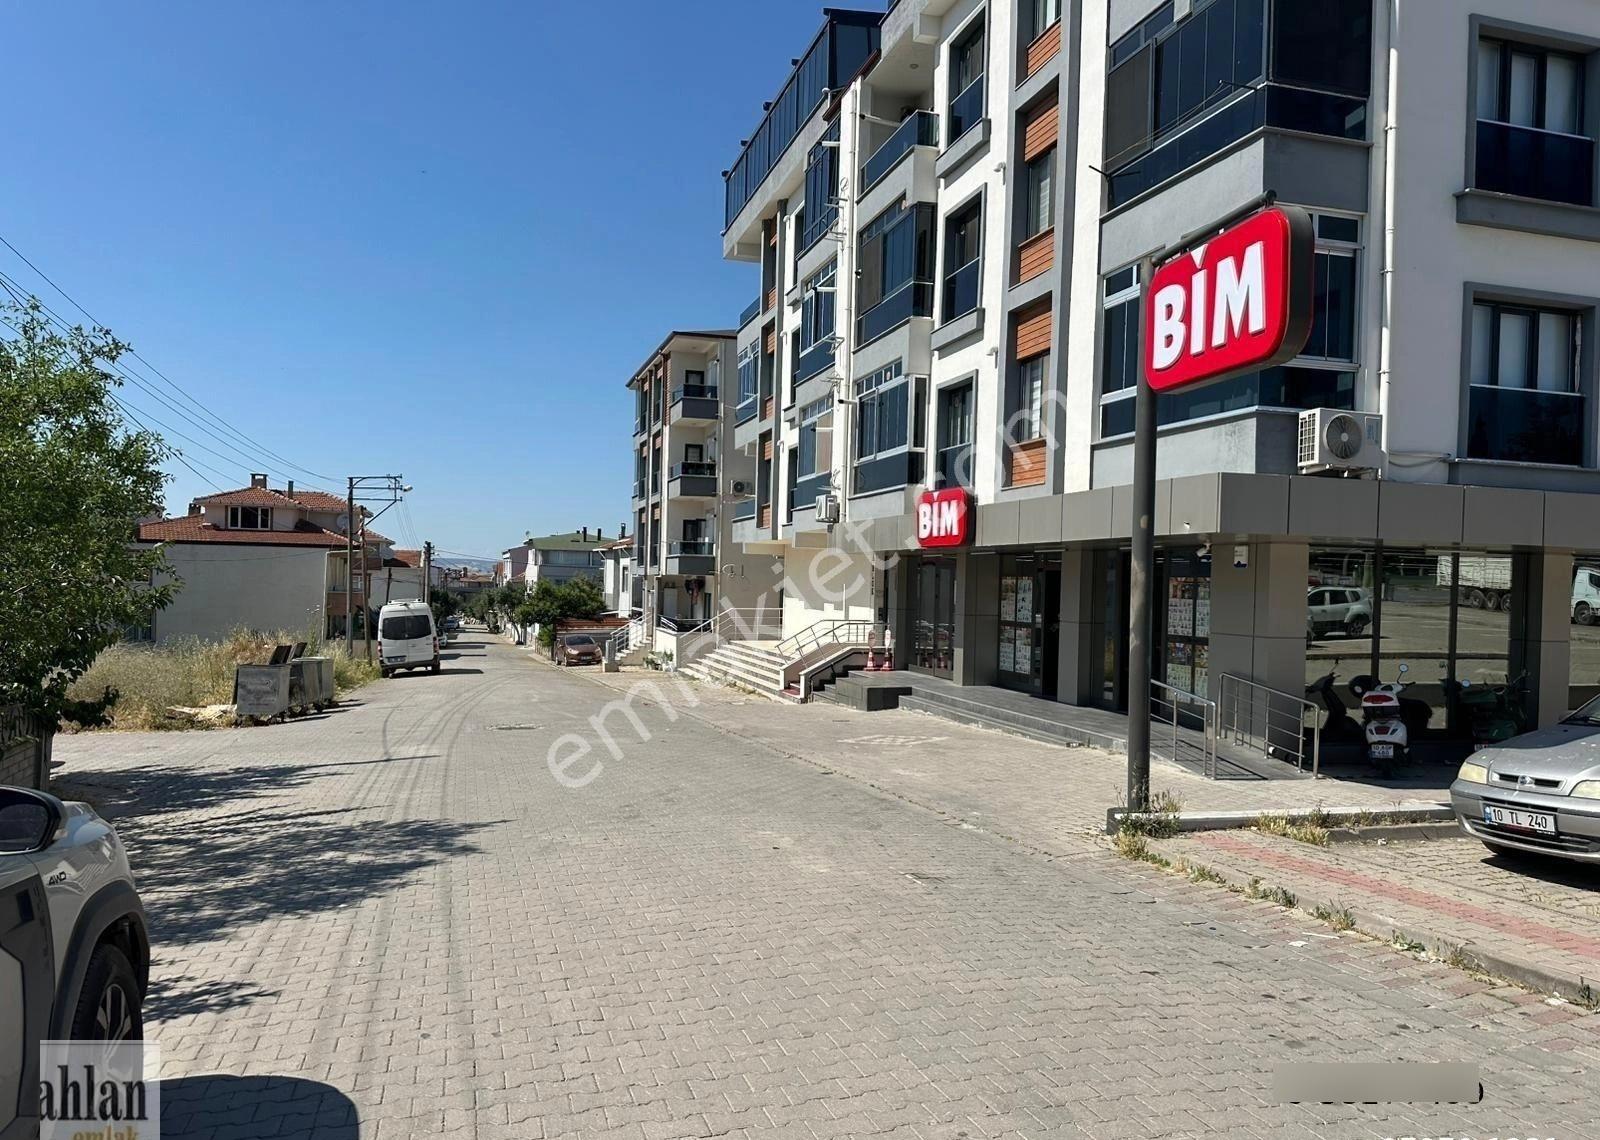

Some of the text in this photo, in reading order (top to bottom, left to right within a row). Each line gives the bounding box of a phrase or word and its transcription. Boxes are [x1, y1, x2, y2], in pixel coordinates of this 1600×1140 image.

[1493, 808, 1548, 829] 10 TL 240
